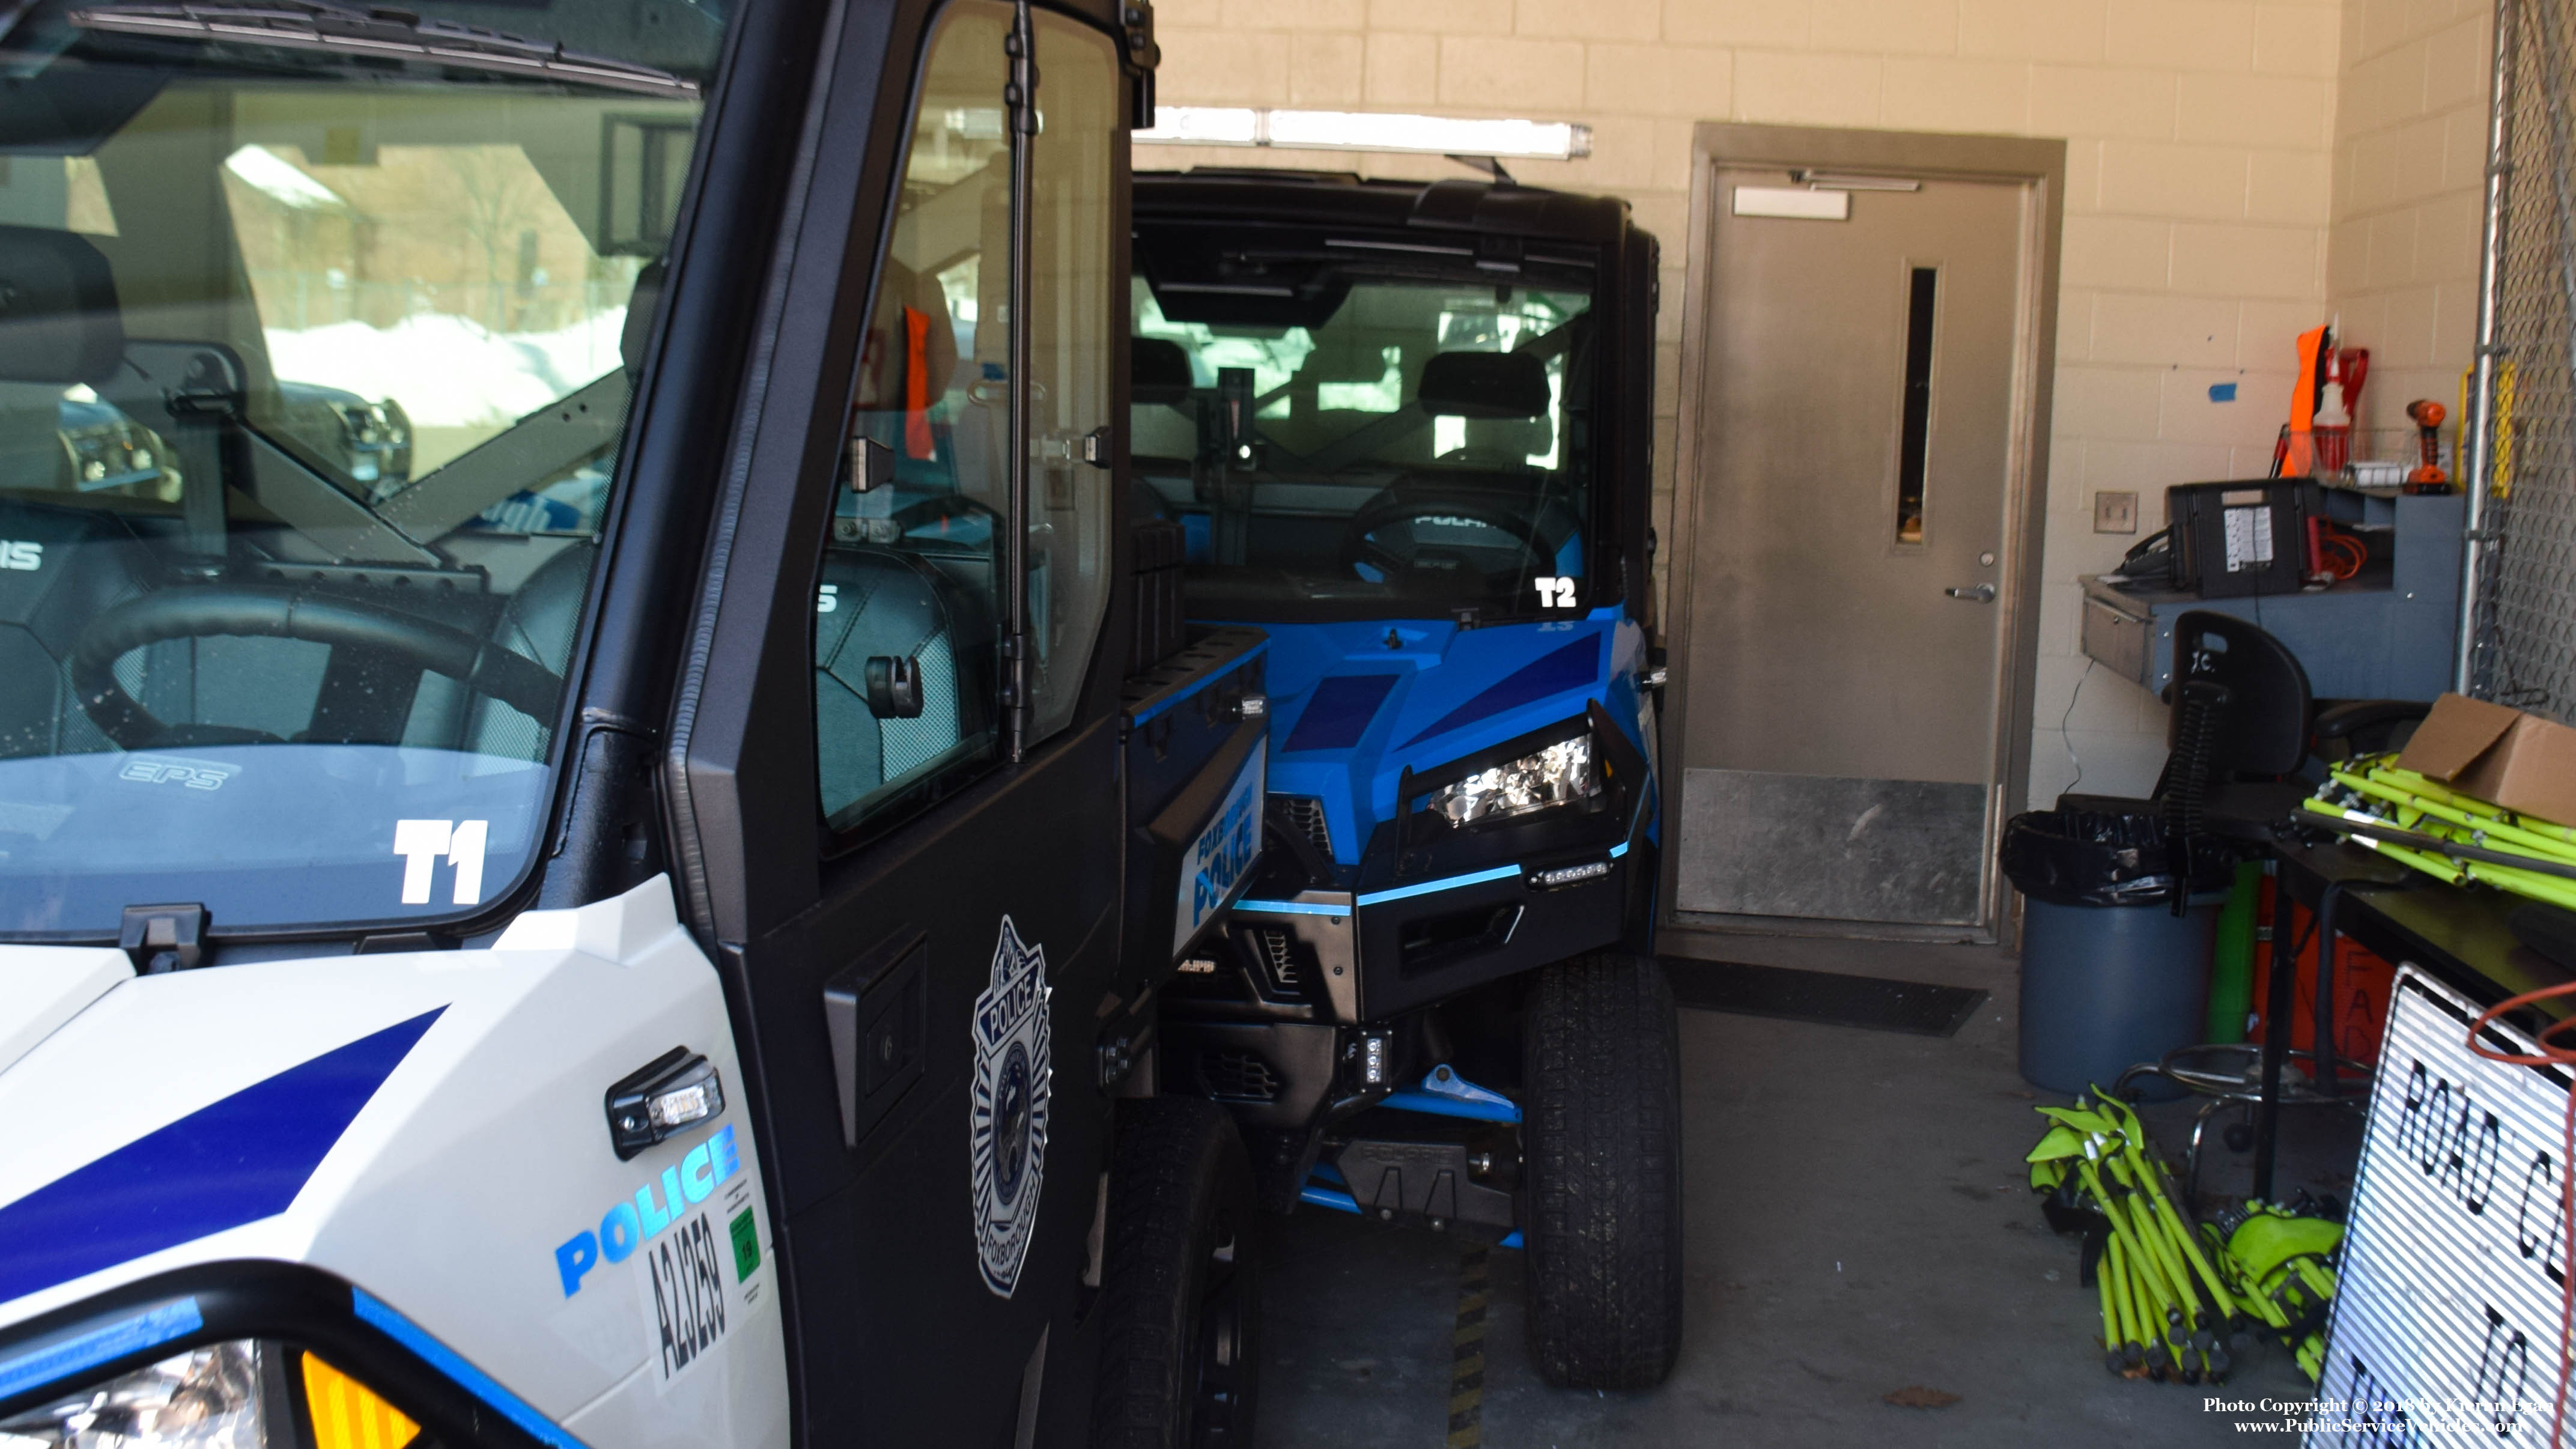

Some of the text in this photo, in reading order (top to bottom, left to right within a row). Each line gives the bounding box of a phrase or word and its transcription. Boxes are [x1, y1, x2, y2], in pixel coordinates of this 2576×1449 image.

[1534, 576, 1576, 607] T2
[119, 761, 229, 791] EPS
[393, 819, 488, 905] T1
[1194, 812, 1252, 928] POLICE
[990, 974, 1032, 1044] POLICE
[2397, 1058, 2499, 1216] ROAD
[554, 1123, 741, 1299] POLICE
[742, 1239, 753, 1262] 19
[986, 1174, 1037, 1265] FOXBOROUGH
[2473, 1302, 2527, 1438] TO
